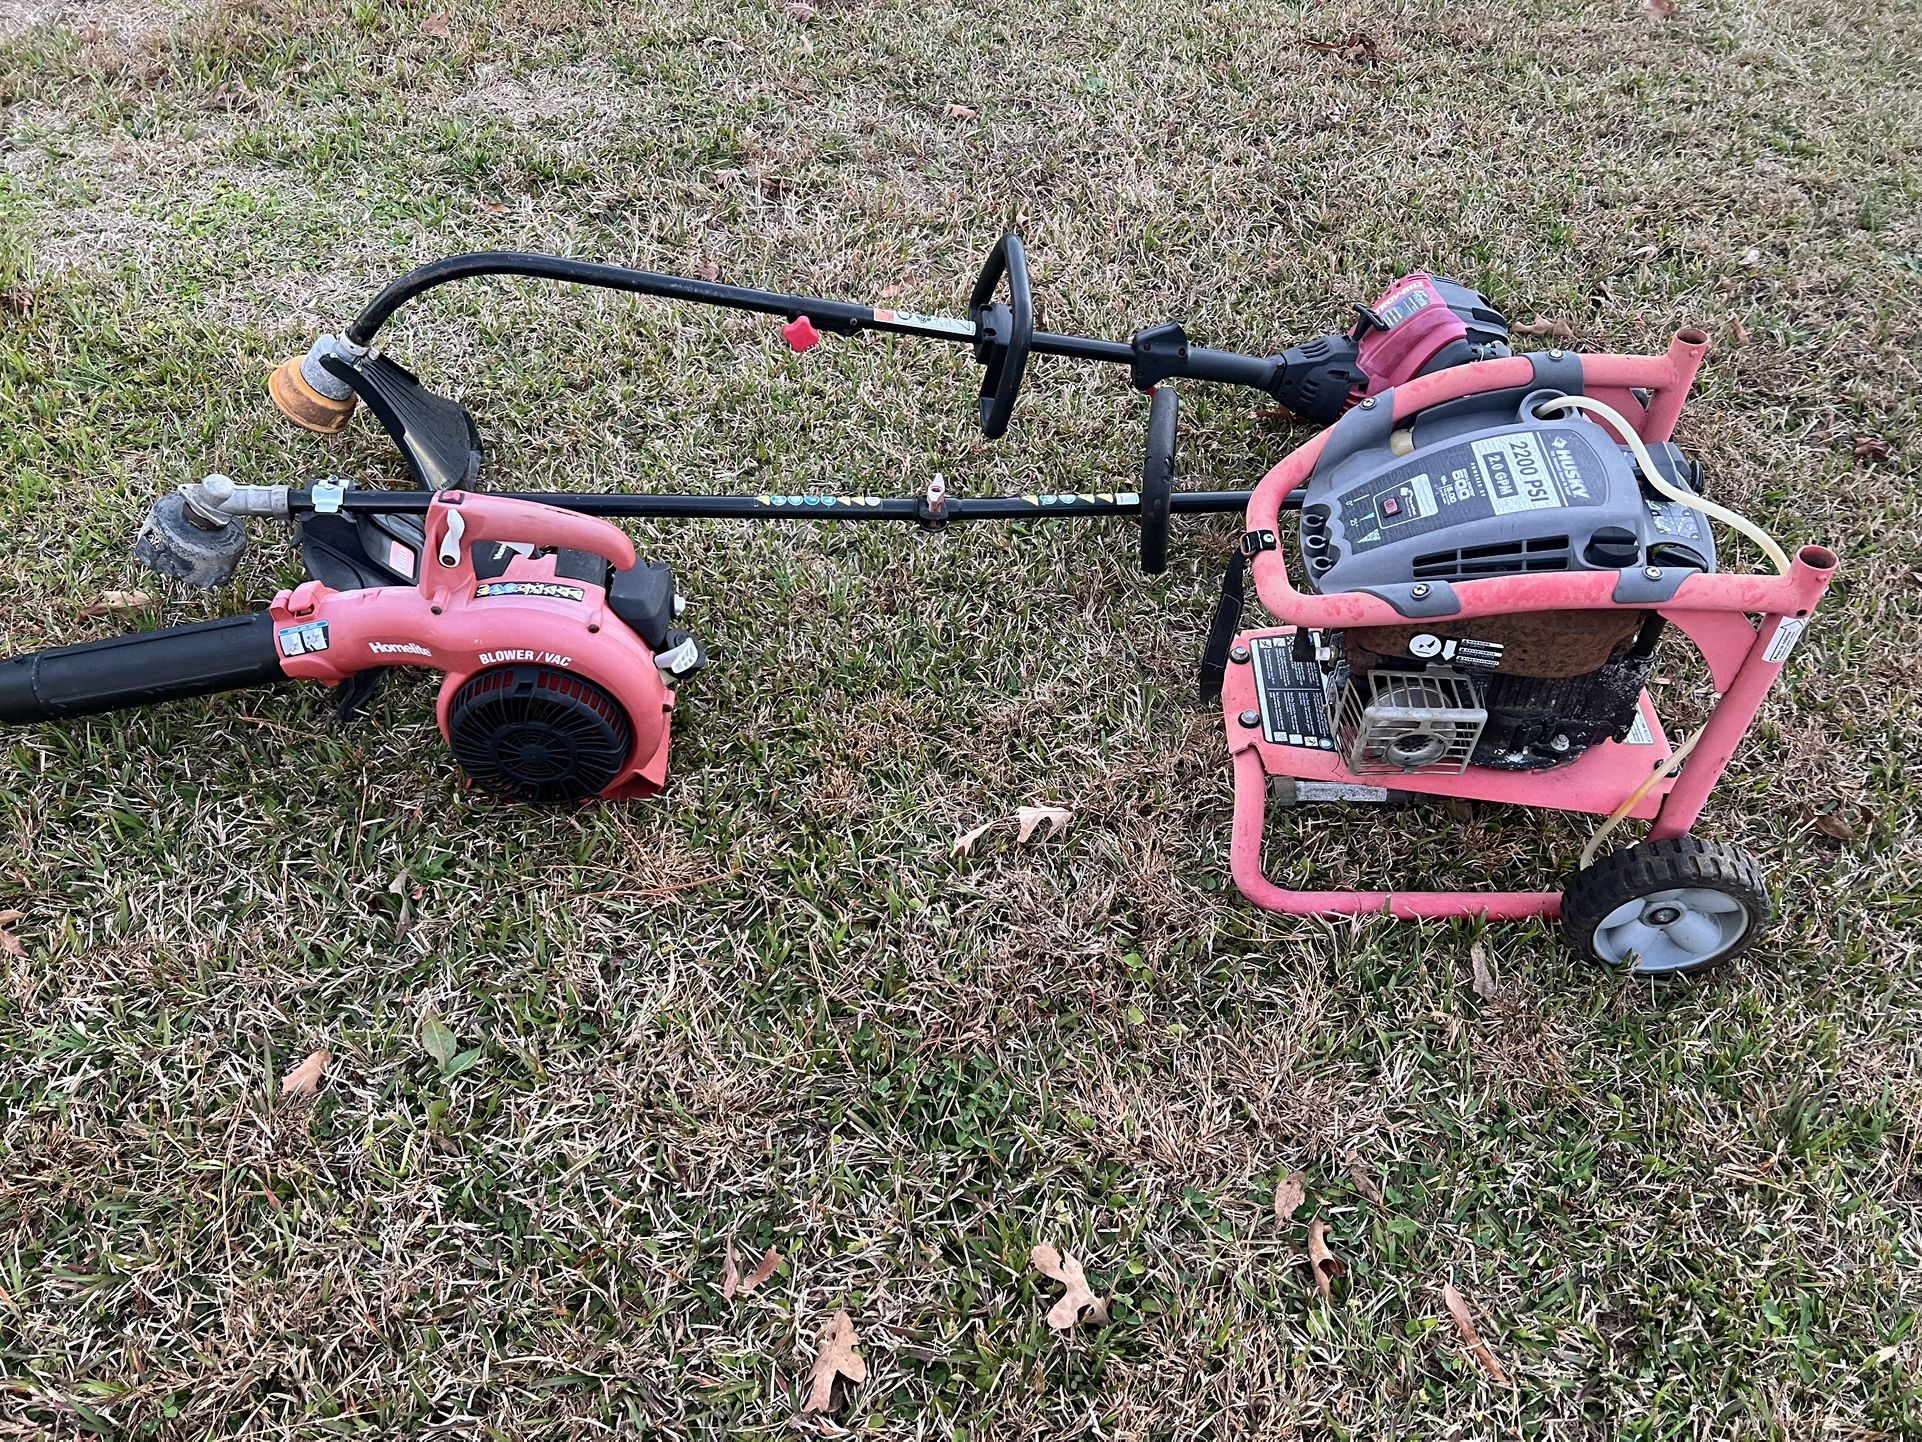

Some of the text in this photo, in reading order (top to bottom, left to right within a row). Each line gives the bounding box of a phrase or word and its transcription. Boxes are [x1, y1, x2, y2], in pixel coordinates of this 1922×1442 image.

[1487, 454, 1514, 496] 2.0 GPM
[1509, 441, 1550, 502] 2200 PSI
[1555, 449, 1590, 498] HUSKY
[368, 641, 432, 657] Homelite
